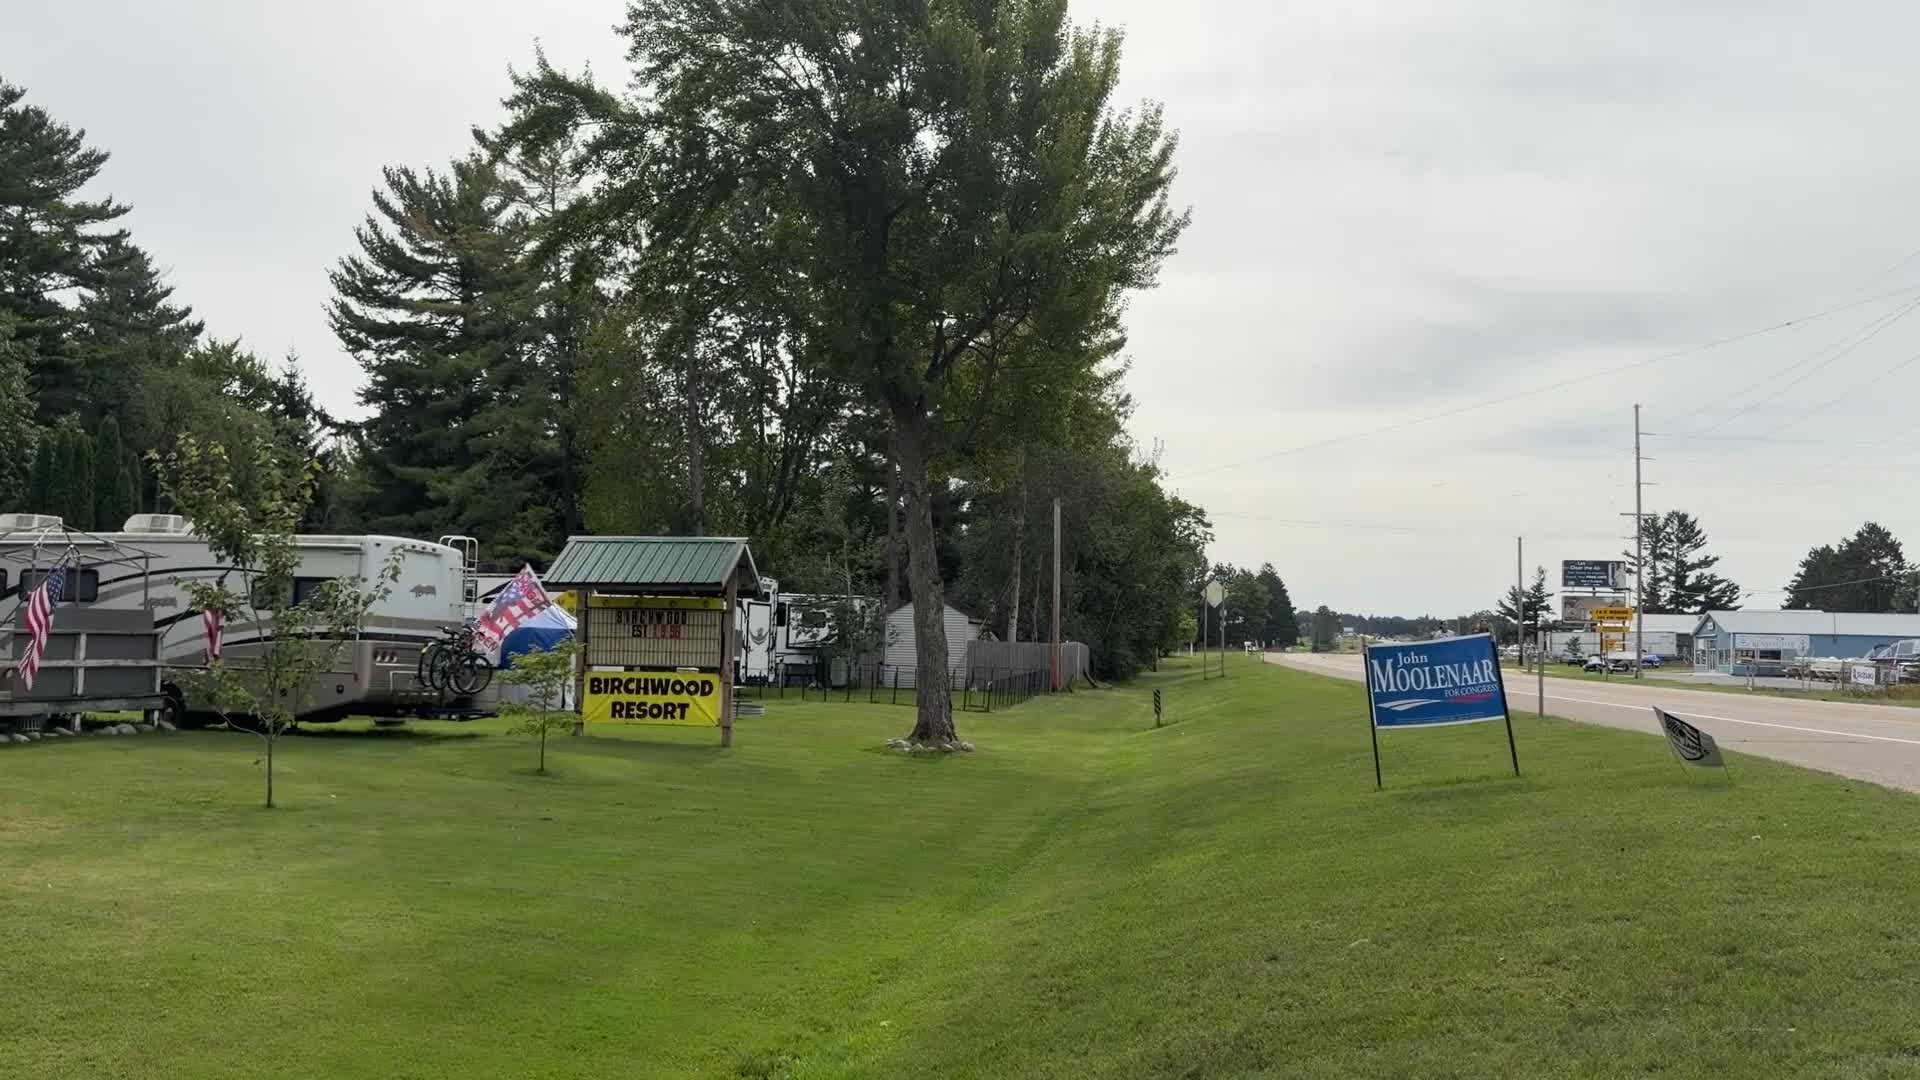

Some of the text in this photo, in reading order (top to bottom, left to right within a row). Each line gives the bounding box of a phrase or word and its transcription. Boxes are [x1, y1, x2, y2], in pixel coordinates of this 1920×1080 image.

[616, 610, 687, 624] BIRCHWOOD
[632, 625, 647, 638] EST
[1397, 651, 1428, 668] John
[590, 677, 714, 697] BIRCHWOOD
[1444, 683, 1499, 697] FOR CONGRESS
[611, 701, 690, 720] RESORT
